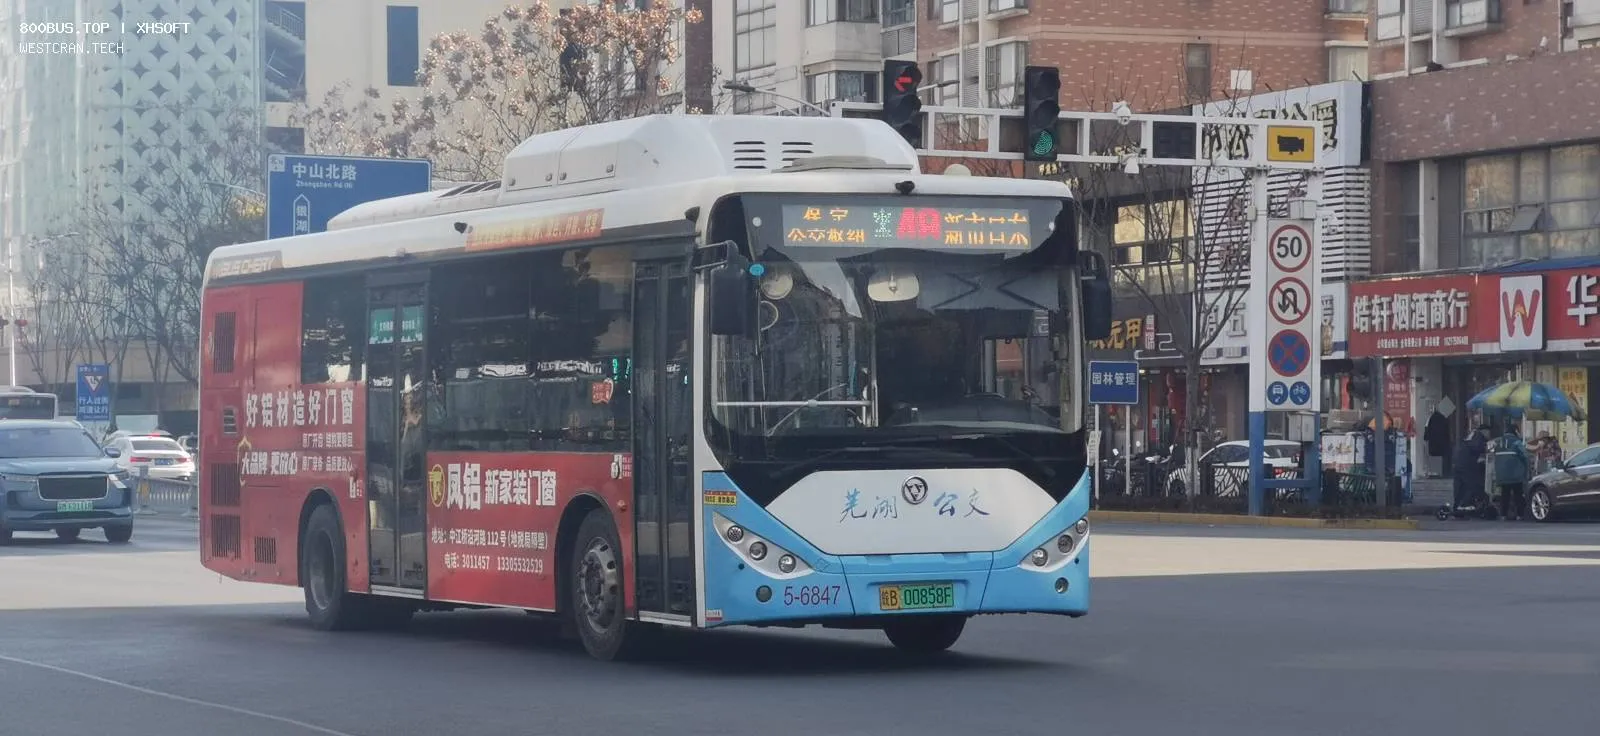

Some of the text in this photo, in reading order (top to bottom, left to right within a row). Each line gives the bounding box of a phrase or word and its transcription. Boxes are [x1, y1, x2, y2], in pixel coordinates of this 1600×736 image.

[292, 162, 357, 181] 中山北路
[1276, 236, 1302, 258] 50
[1353, 288, 1470, 333] 皓轩烟酒商行
[1565, 275, 1598, 327] 华
[1090, 318, 1142, 350] 元甲
[1091, 371, 1137, 387] 园林管理
[246, 387, 353, 428] 好铝材造好门窗
[241, 451, 298, 475] 大品牌 更放心
[446, 461, 556, 510] 凤铝 新家装门窗
[839, 487, 991, 524] 芜湖 公交
[783, 585, 841, 607] 5-6847
